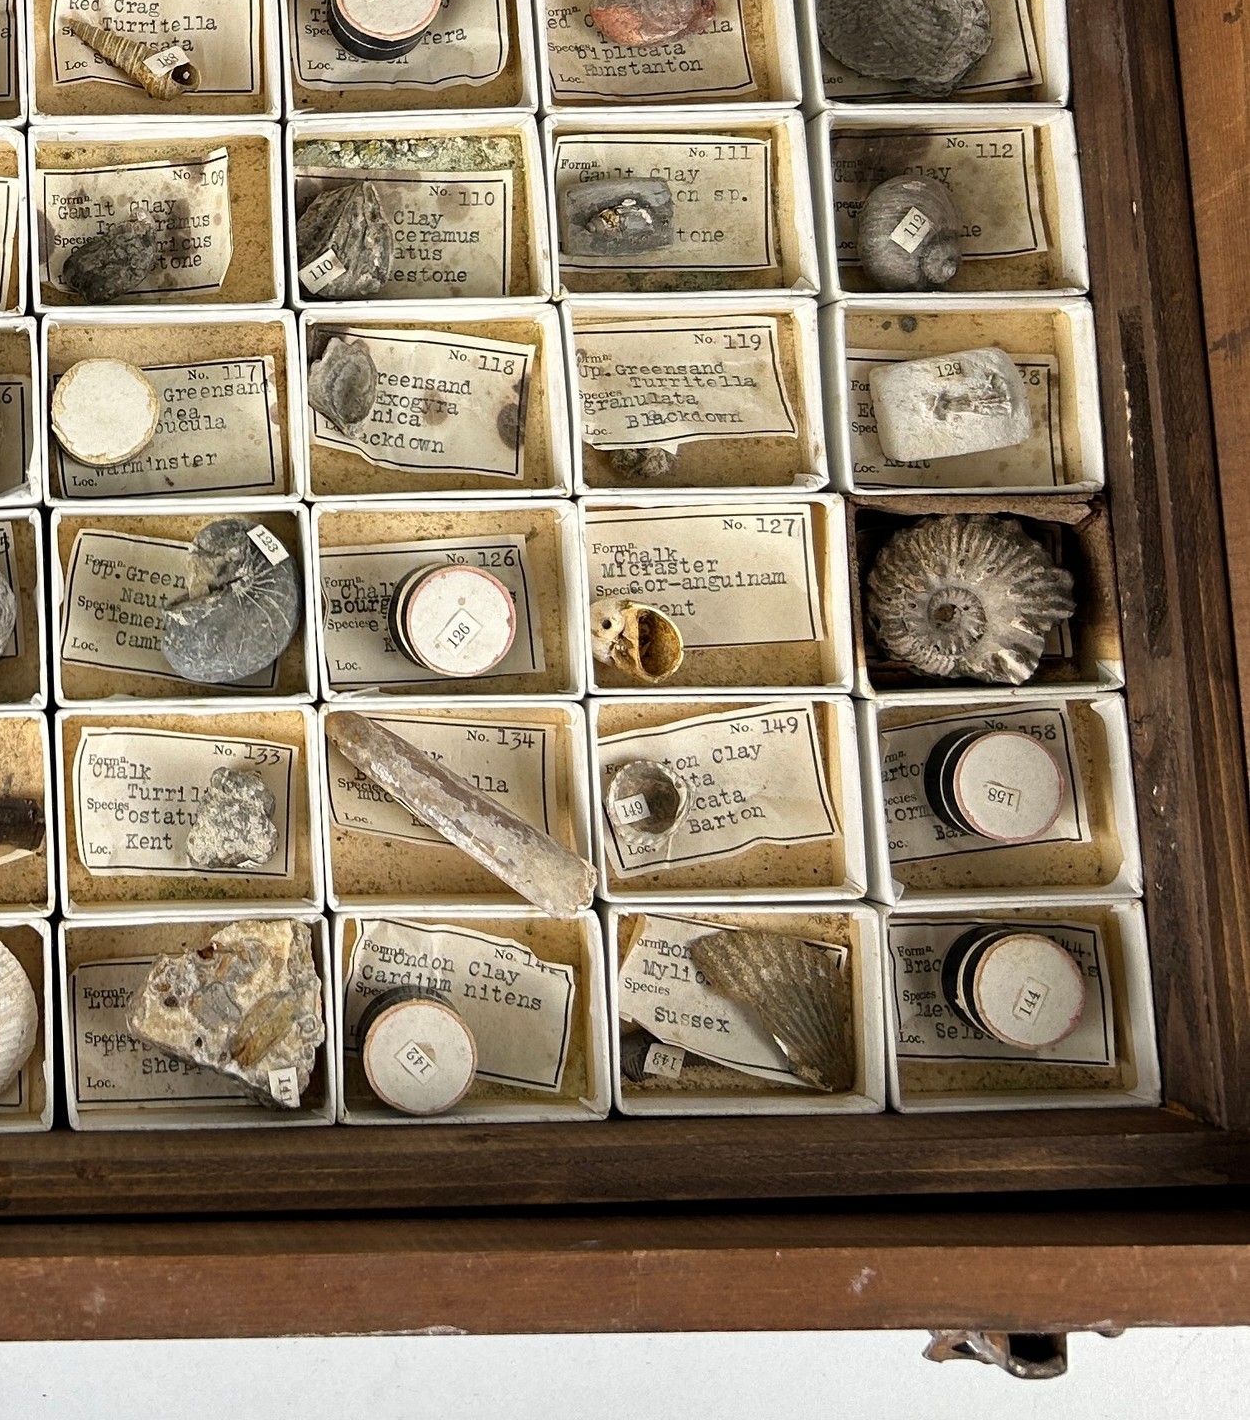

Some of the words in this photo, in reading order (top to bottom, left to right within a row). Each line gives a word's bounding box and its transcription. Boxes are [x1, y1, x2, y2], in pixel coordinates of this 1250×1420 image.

[102, 16, 218, 34] Turritella
[306, 59, 334, 71] Loc.
[583, 59, 704, 78] Hunstanton
[714, 146, 752, 161] 111
[946, 137, 968, 150] No.
[975, 143, 1014, 159] 112
[200, 170, 225, 188] 109
[579, 166, 634, 183] Gault
[650, 166, 701, 183] Clay
[428, 185, 451, 197] No.
[458, 190, 495, 206] 110
[57, 201, 115, 221] Gault
[393, 210, 444, 229] Clay
[903, 214, 927, 239] 112
[310, 258, 334, 282] 110
[693, 333, 717, 345] No.
[723, 333, 761, 351] 119
[187, 369, 210, 380] No.
[222, 365, 258, 382] 117
[477, 354, 515, 376] 118
[935, 362, 962, 379] 129
[163, 380, 271, 403] Greensand
[376, 370, 472, 395] reensand
[629, 375, 757, 390] Turritella
[375, 389, 459, 416] Exogyra
[583, 391, 699, 416] granulata
[625, 410, 744, 430] Blackdown
[585, 424, 612, 437] Loc.
[853, 462, 880, 474] Loc.
[72, 475, 98, 487] Loc.
[722, 518, 747, 531] No.
[756, 518, 797, 537] 127
[254, 529, 279, 553] 123
[446, 553, 470, 565] No.
[478, 549, 515, 567] 126
[614, 547, 679, 564] Chalk
[601, 557, 720, 579] Micraster
[77, 595, 122, 614] Species
[446, 621, 472, 650] 126
[71, 638, 99, 653] Loc.
[336, 659, 362, 672] Loc.
[761, 716, 799, 734] 149
[984, 719, 1008, 731] No.
[467, 729, 489, 742] No.
[497, 728, 535, 750] 134
[213, 744, 237, 757] No.
[244, 742, 281, 766] 133
[712, 743, 762, 765] Clay
[92, 763, 152, 781] Chalk
[86, 797, 129, 812] Species
[622, 800, 643, 818] 149
[688, 804, 766, 835] Barton
[89, 842, 112, 855] Loc.
[126, 832, 173, 850] Kent
[627, 843, 656, 855] Loc.
[493, 947, 517, 962] No.
[378, 948, 456, 973] London
[469, 960, 521, 986] Clay
[623, 976, 670, 995] Species
[463, 982, 543, 1011] nitens
[1019, 989, 1042, 1017] 144
[654, 1007, 731, 1034] Sussex
[899, 1031, 925, 1044] Loc.
[86, 1076, 116, 1089] Loc.
